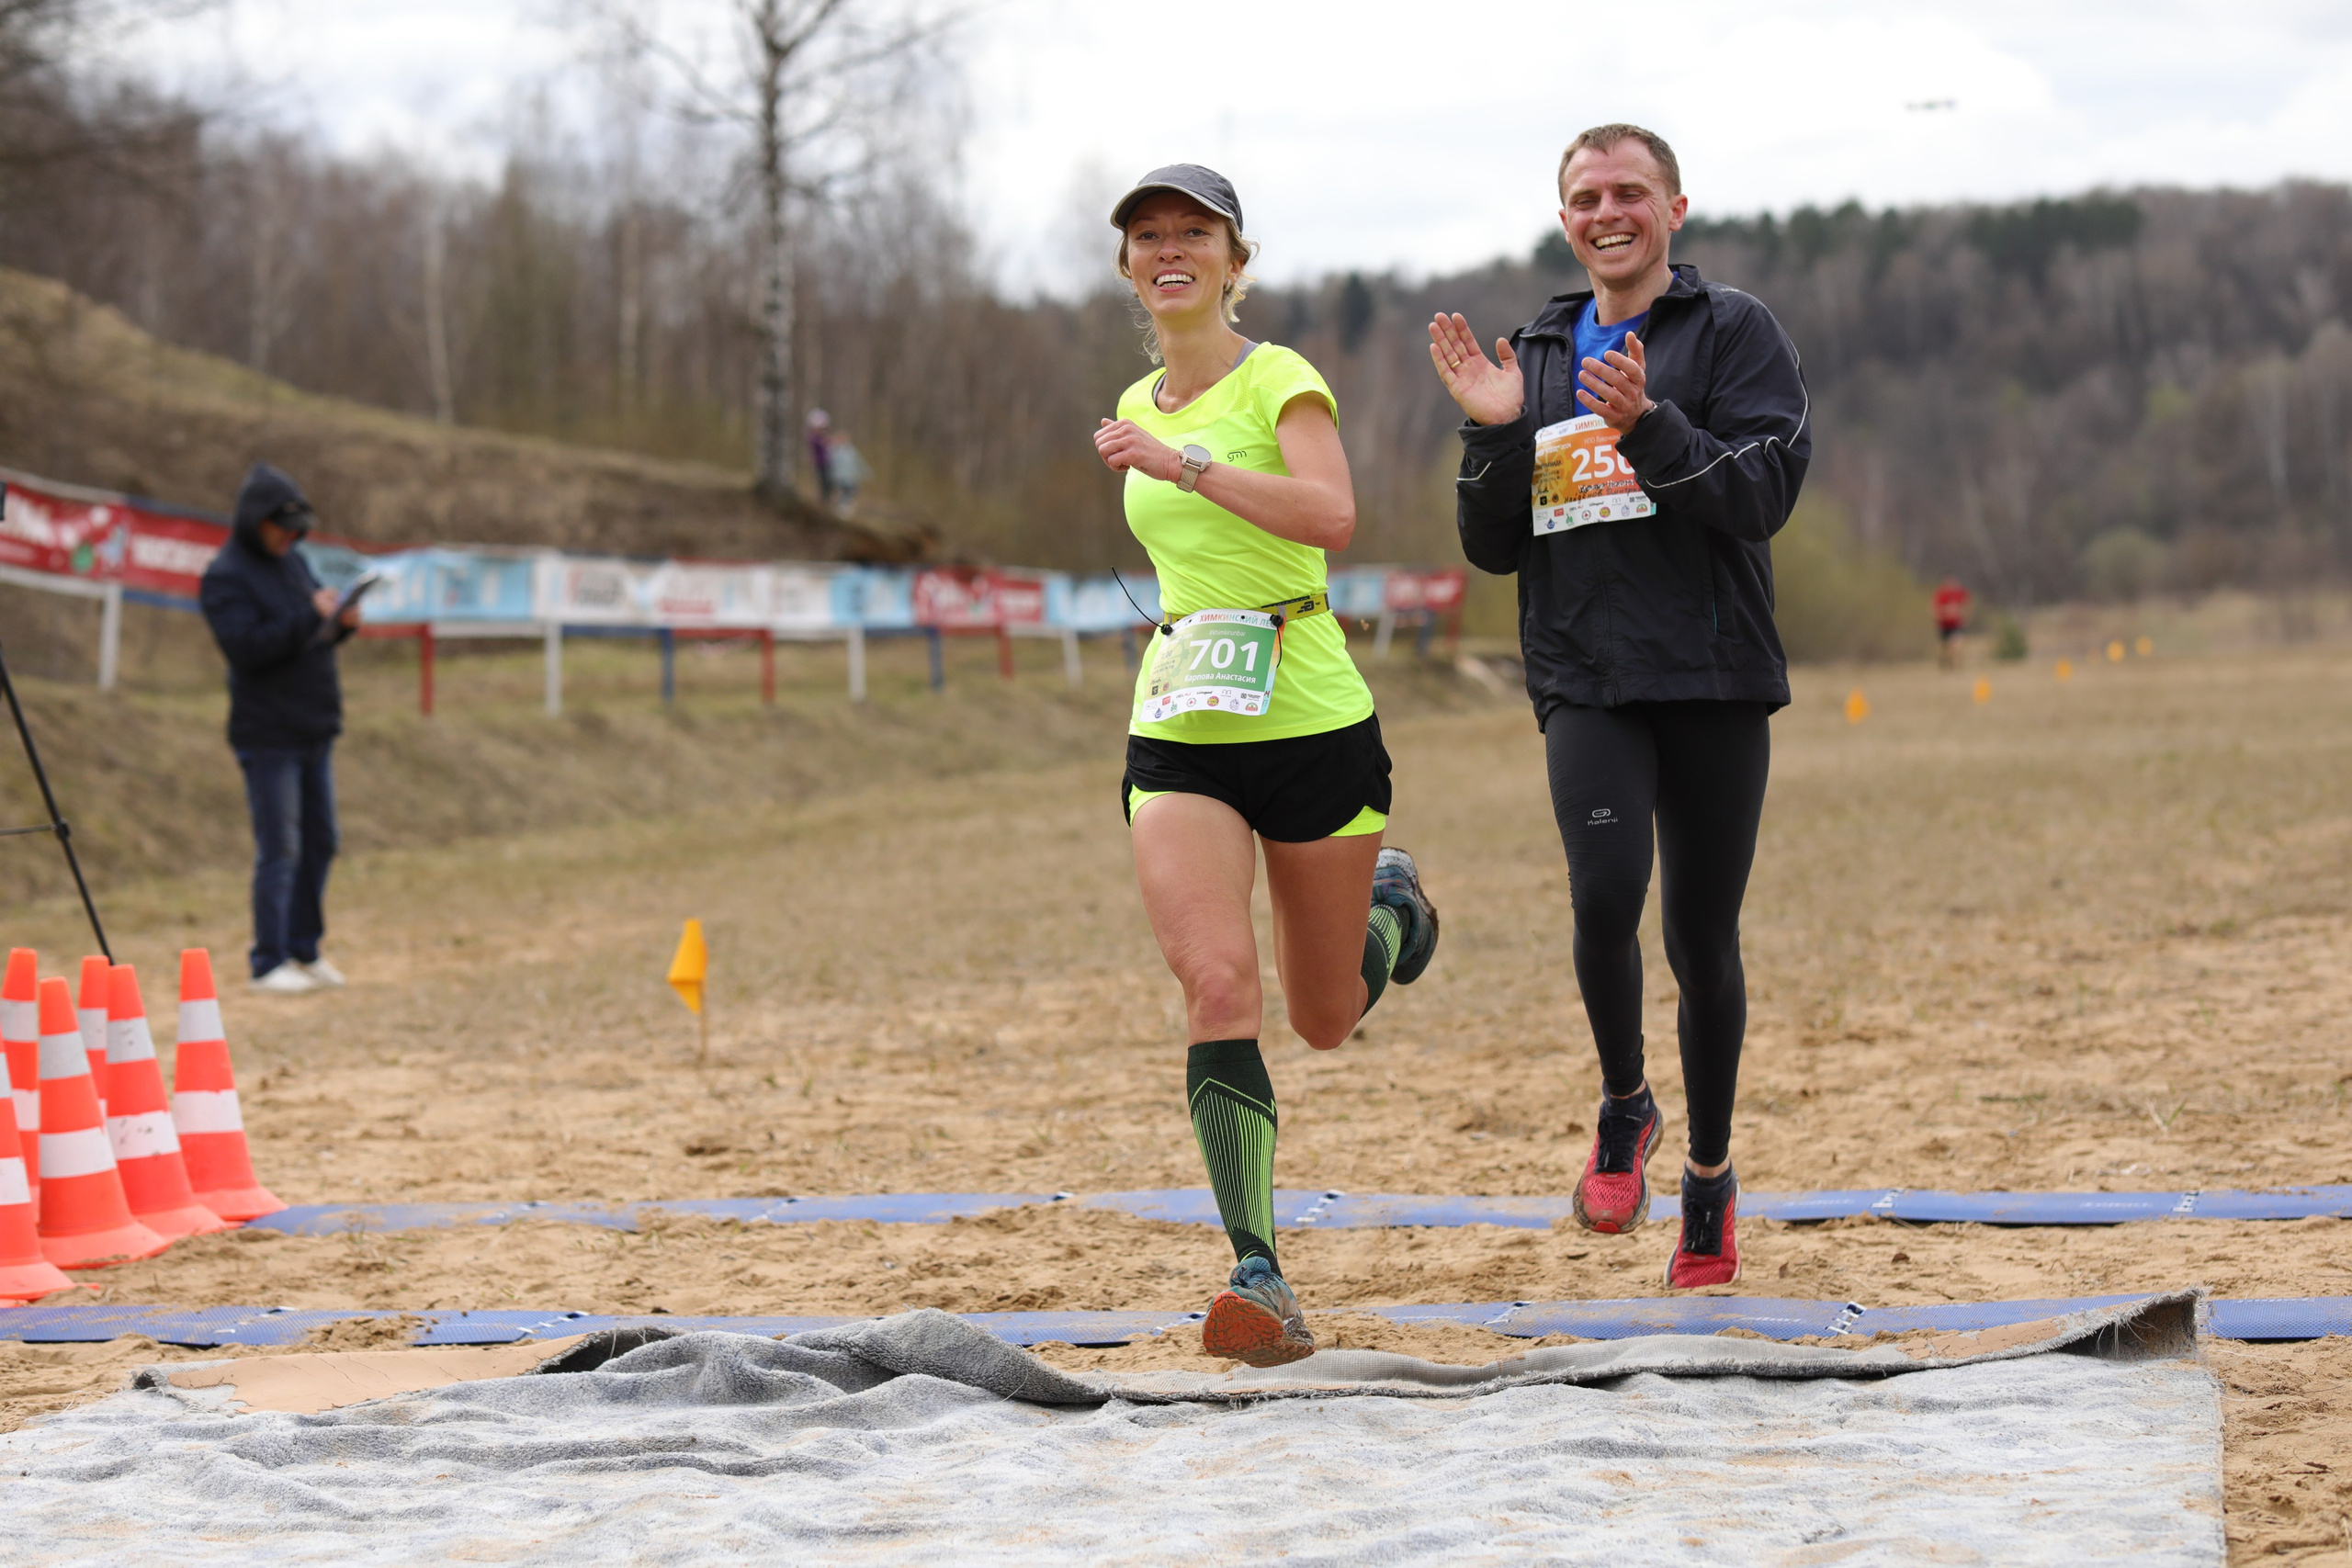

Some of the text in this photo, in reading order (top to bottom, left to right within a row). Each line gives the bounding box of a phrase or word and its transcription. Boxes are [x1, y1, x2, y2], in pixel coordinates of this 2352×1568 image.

[1189, 637, 1259, 671] 701
[1184, 671, 1256, 683] Карпова Анастасия
[1587, 817, 1618, 826] Kalenji
